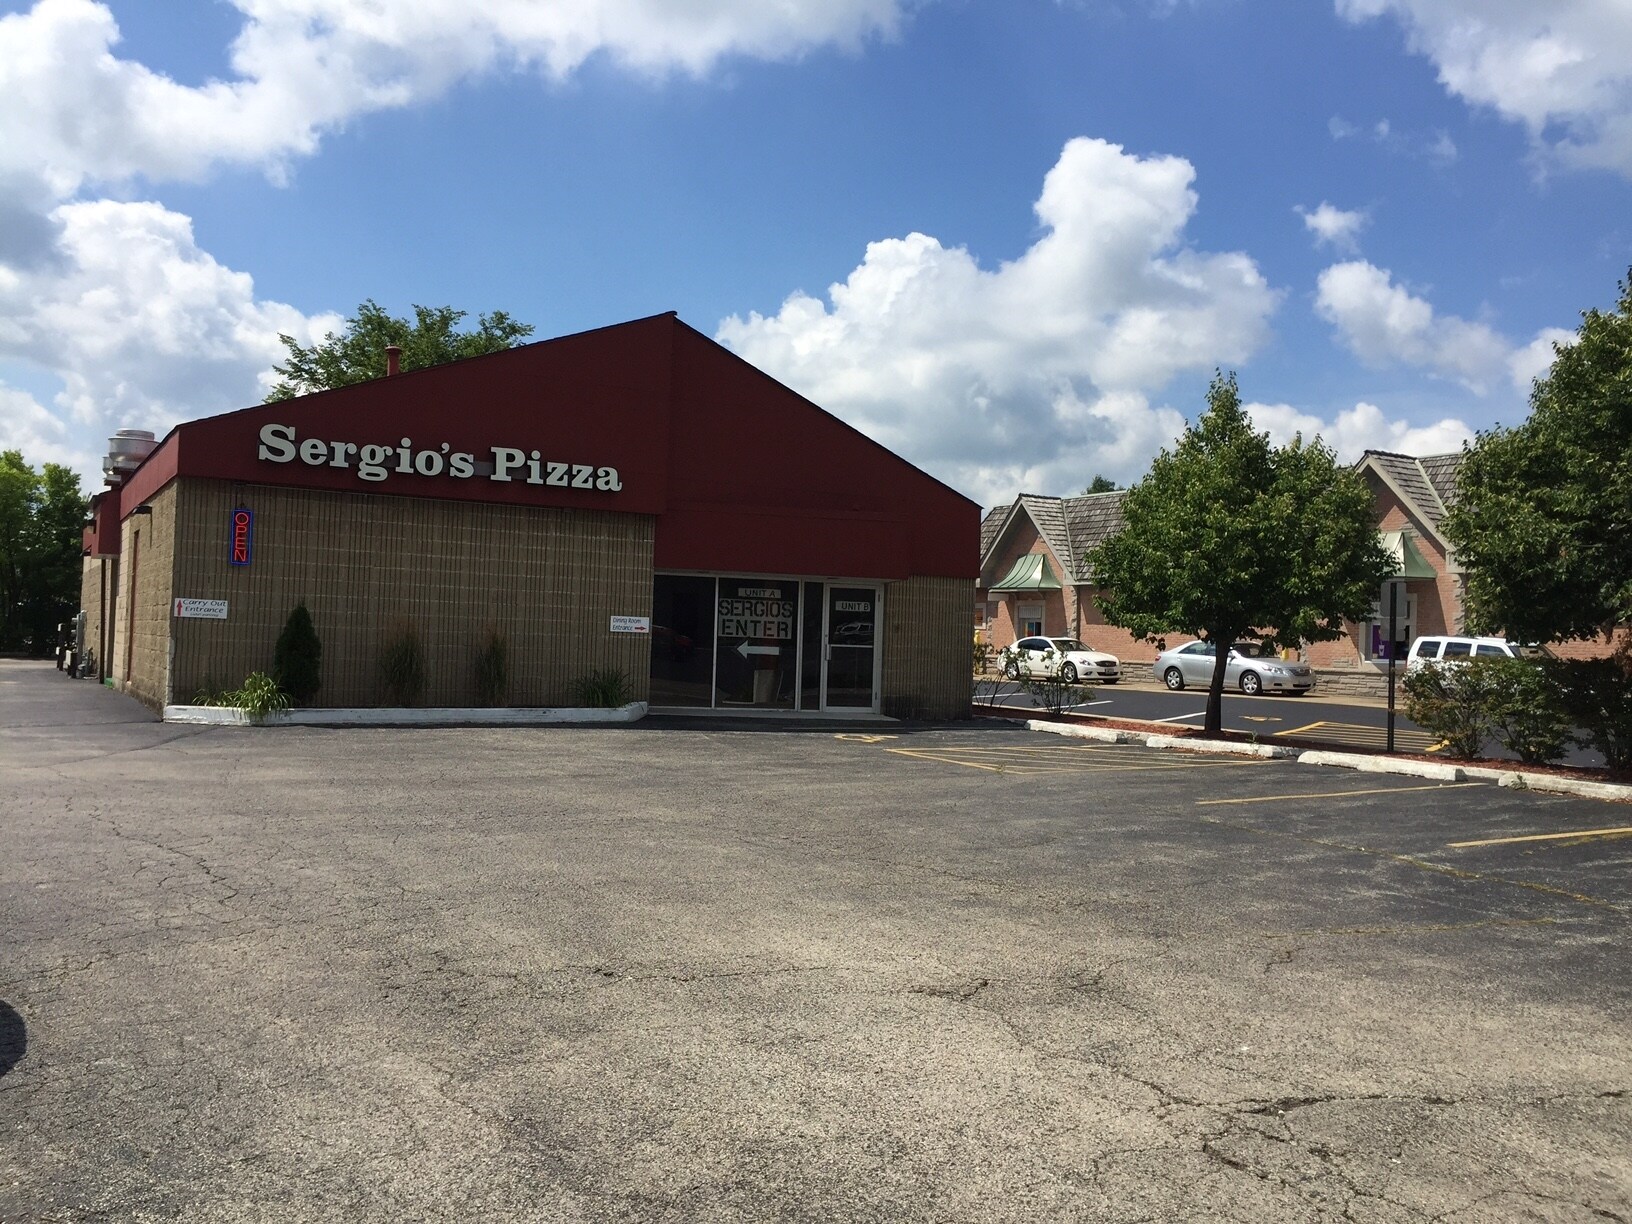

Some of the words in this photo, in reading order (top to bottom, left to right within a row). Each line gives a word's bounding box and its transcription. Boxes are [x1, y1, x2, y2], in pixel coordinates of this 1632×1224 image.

[258, 423, 475, 482] Sergio's
[490, 446, 623, 492] Pizza
[234, 512, 249, 562] OPEN
[744, 588, 768, 597] UNIT
[769, 590, 776, 598] A
[182, 599, 208, 608] Carry
[841, 602, 862, 611] UNIT
[863, 603, 870, 611] B
[184, 606, 224, 614] Entrance
[718, 600, 793, 619] SERGIOS
[612, 617, 627, 625] Dining
[721, 618, 789, 638] ENTER
